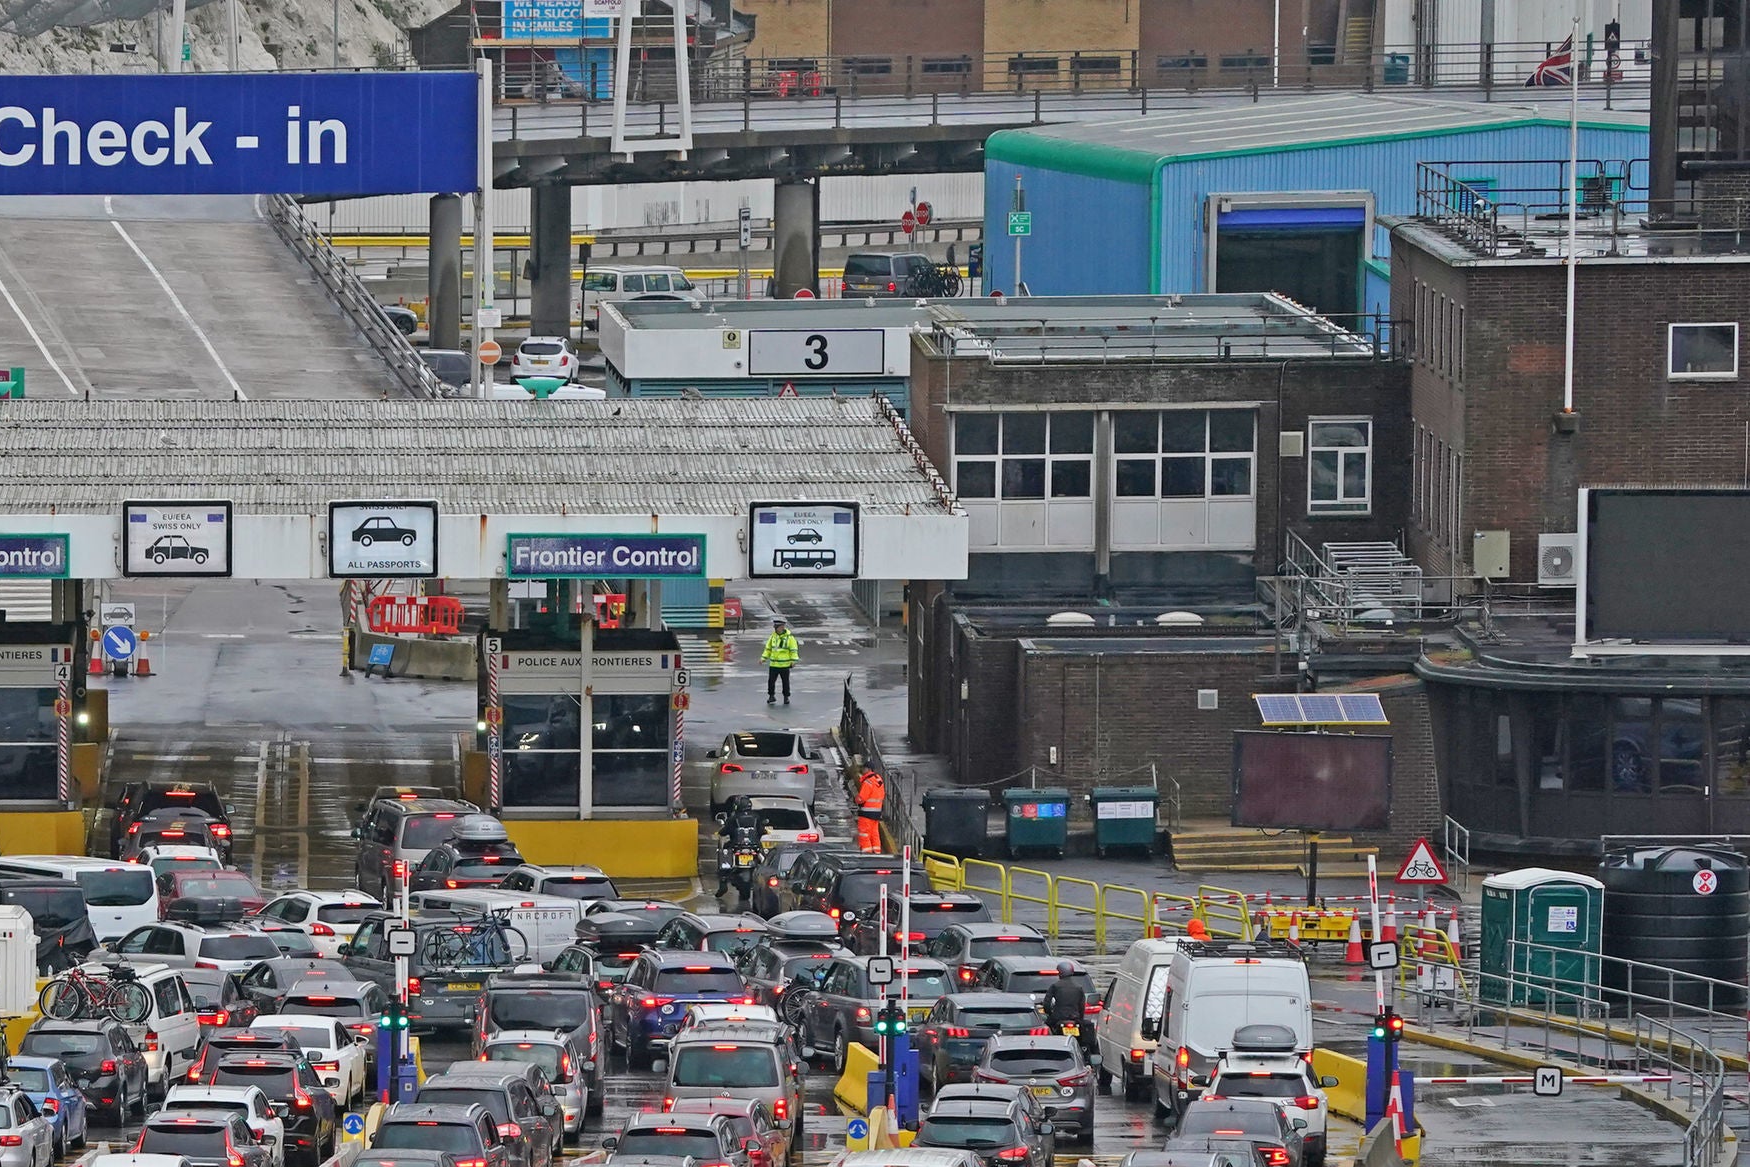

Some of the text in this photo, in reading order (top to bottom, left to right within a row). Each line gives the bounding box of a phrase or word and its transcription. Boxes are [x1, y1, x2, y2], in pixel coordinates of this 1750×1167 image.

[513, 8, 540, 18] OUR
[513, 21, 573, 32] IN SMILES
[287, 106, 348, 163] in
[804, 335, 828, 369] 3
[516, 546, 698, 567] Frontier Control
[489, 638, 498, 650] 5
[518, 657, 653, 666] POLICE AUX RONTIERES
[59, 667, 67, 678] 4
[678, 671, 686, 682] 6
[1542, 1075, 1554, 1087] M
